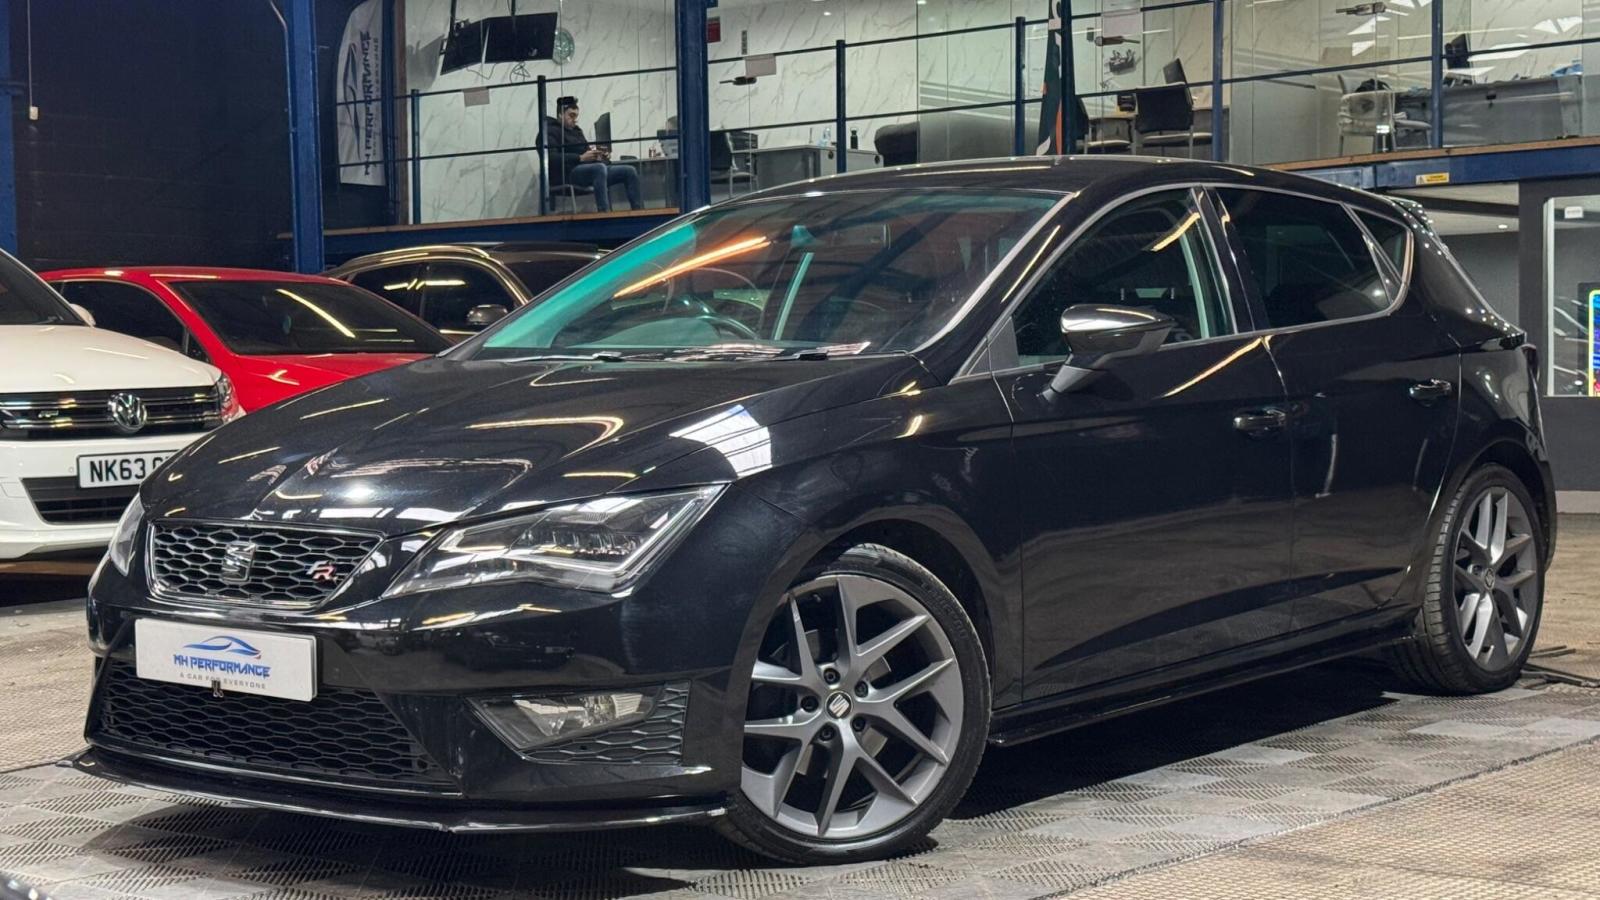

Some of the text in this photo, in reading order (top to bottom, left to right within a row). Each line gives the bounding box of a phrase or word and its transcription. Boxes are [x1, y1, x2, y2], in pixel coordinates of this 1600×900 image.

[89, 458, 146, 482] NK63
[173, 654, 271, 679] MH PERFORMANCE
[223, 679, 266, 689] EVERYONE
